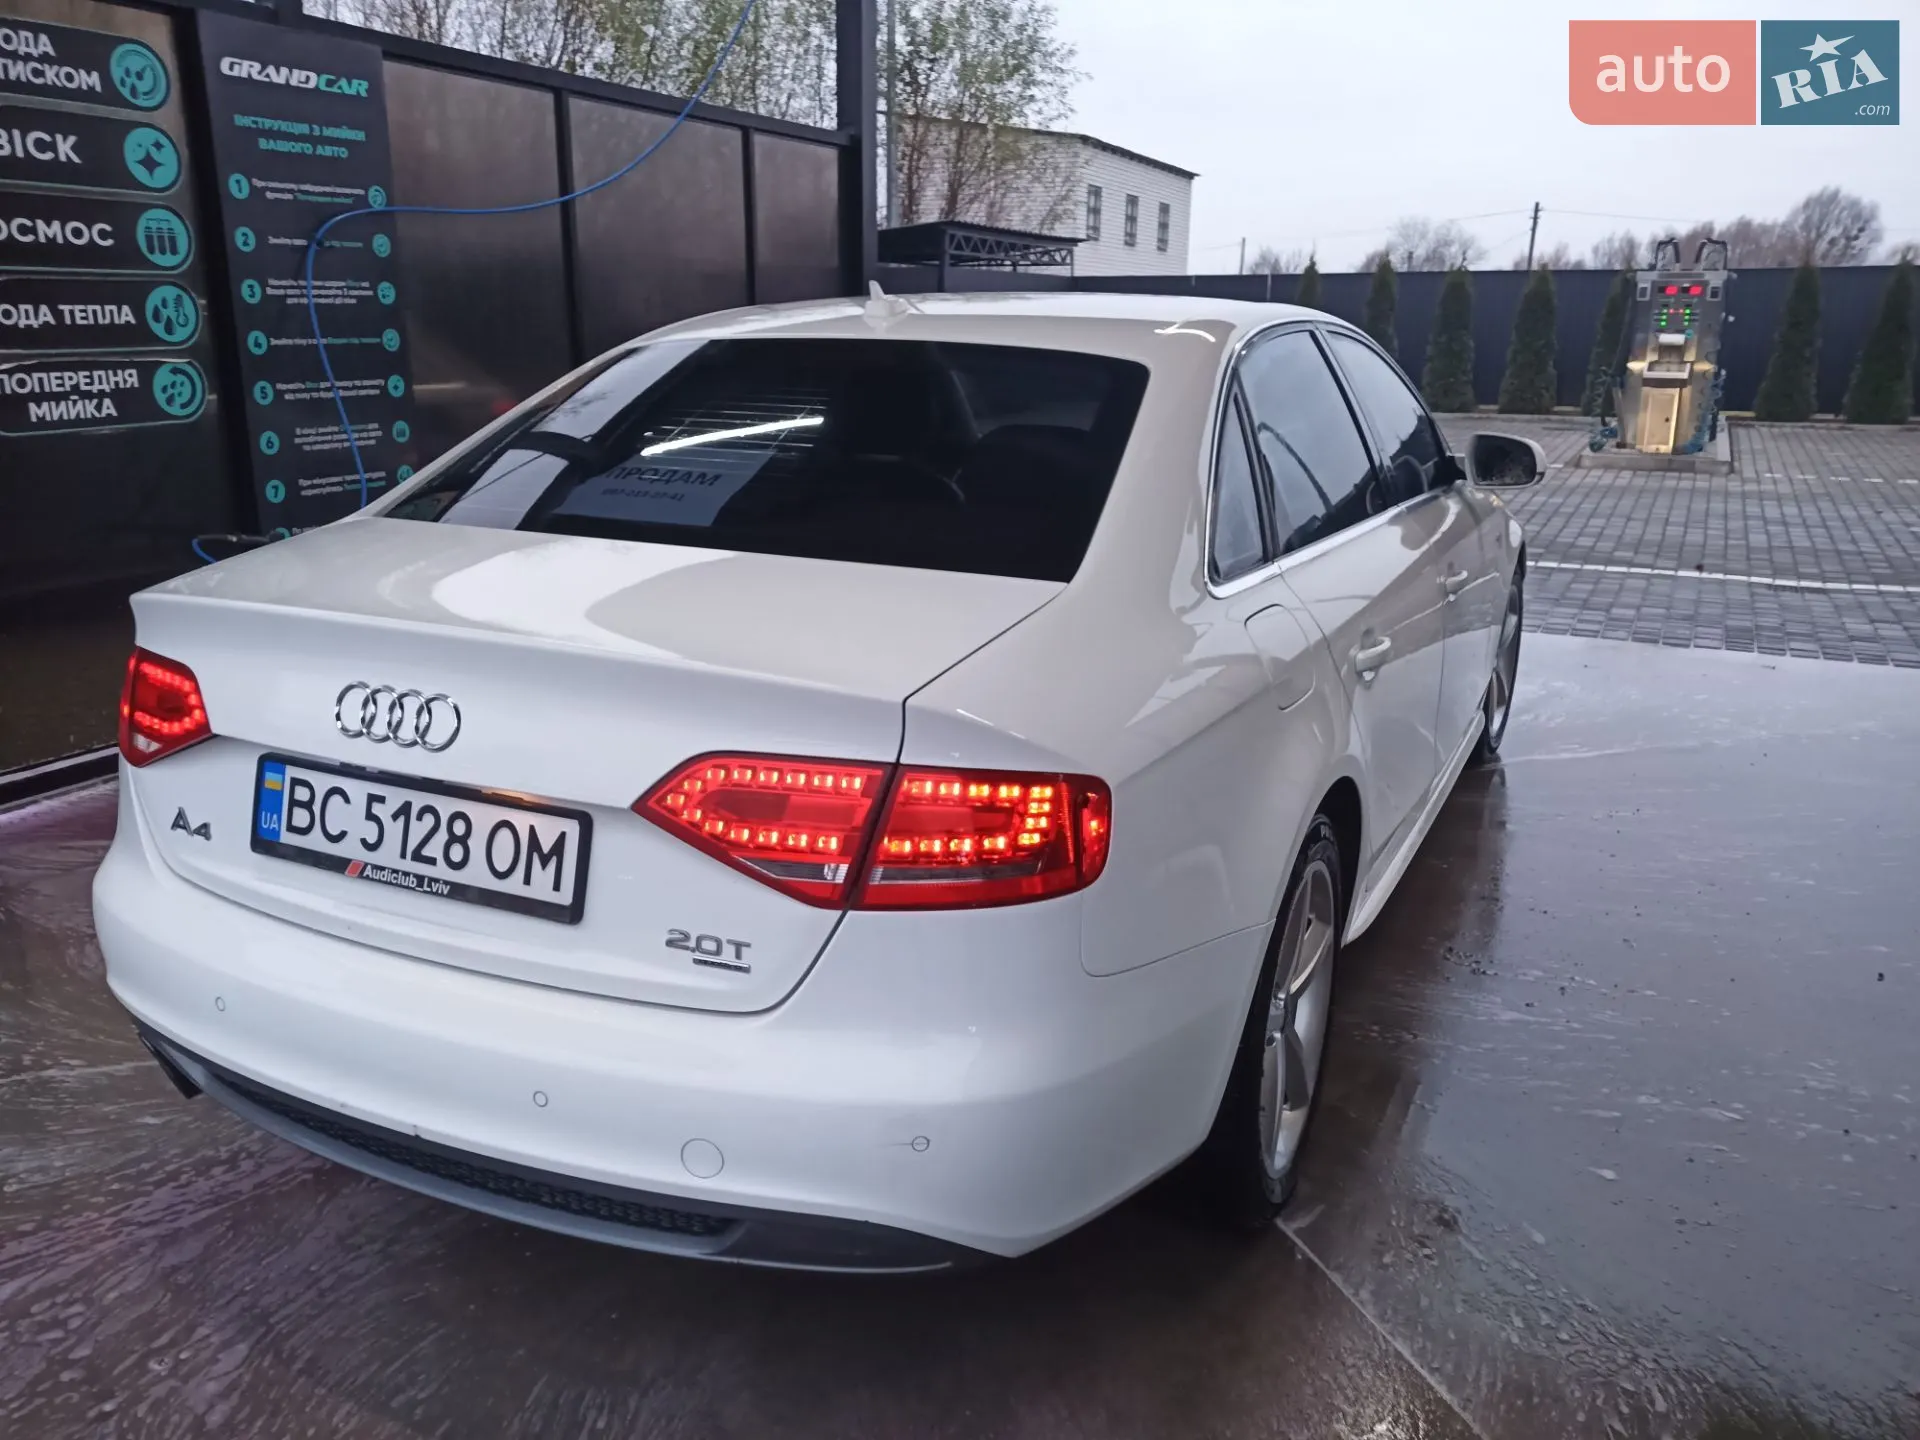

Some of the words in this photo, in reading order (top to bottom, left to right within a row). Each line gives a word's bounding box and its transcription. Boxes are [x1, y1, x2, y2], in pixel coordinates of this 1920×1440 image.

[219, 56, 369, 97] GRANDCAR
[58, 304, 136, 324] ТЕПЛА
[28, 395, 118, 422] МИЙКА
[605, 466, 722, 487] ПРОДАМ
[171, 806, 212, 841] A4
[261, 811, 280, 831] UA
[286, 776, 351, 844] BC
[360, 792, 472, 870] 5128
[486, 819, 567, 892] OM
[363, 864, 451, 895] Audiclub_Lviv
